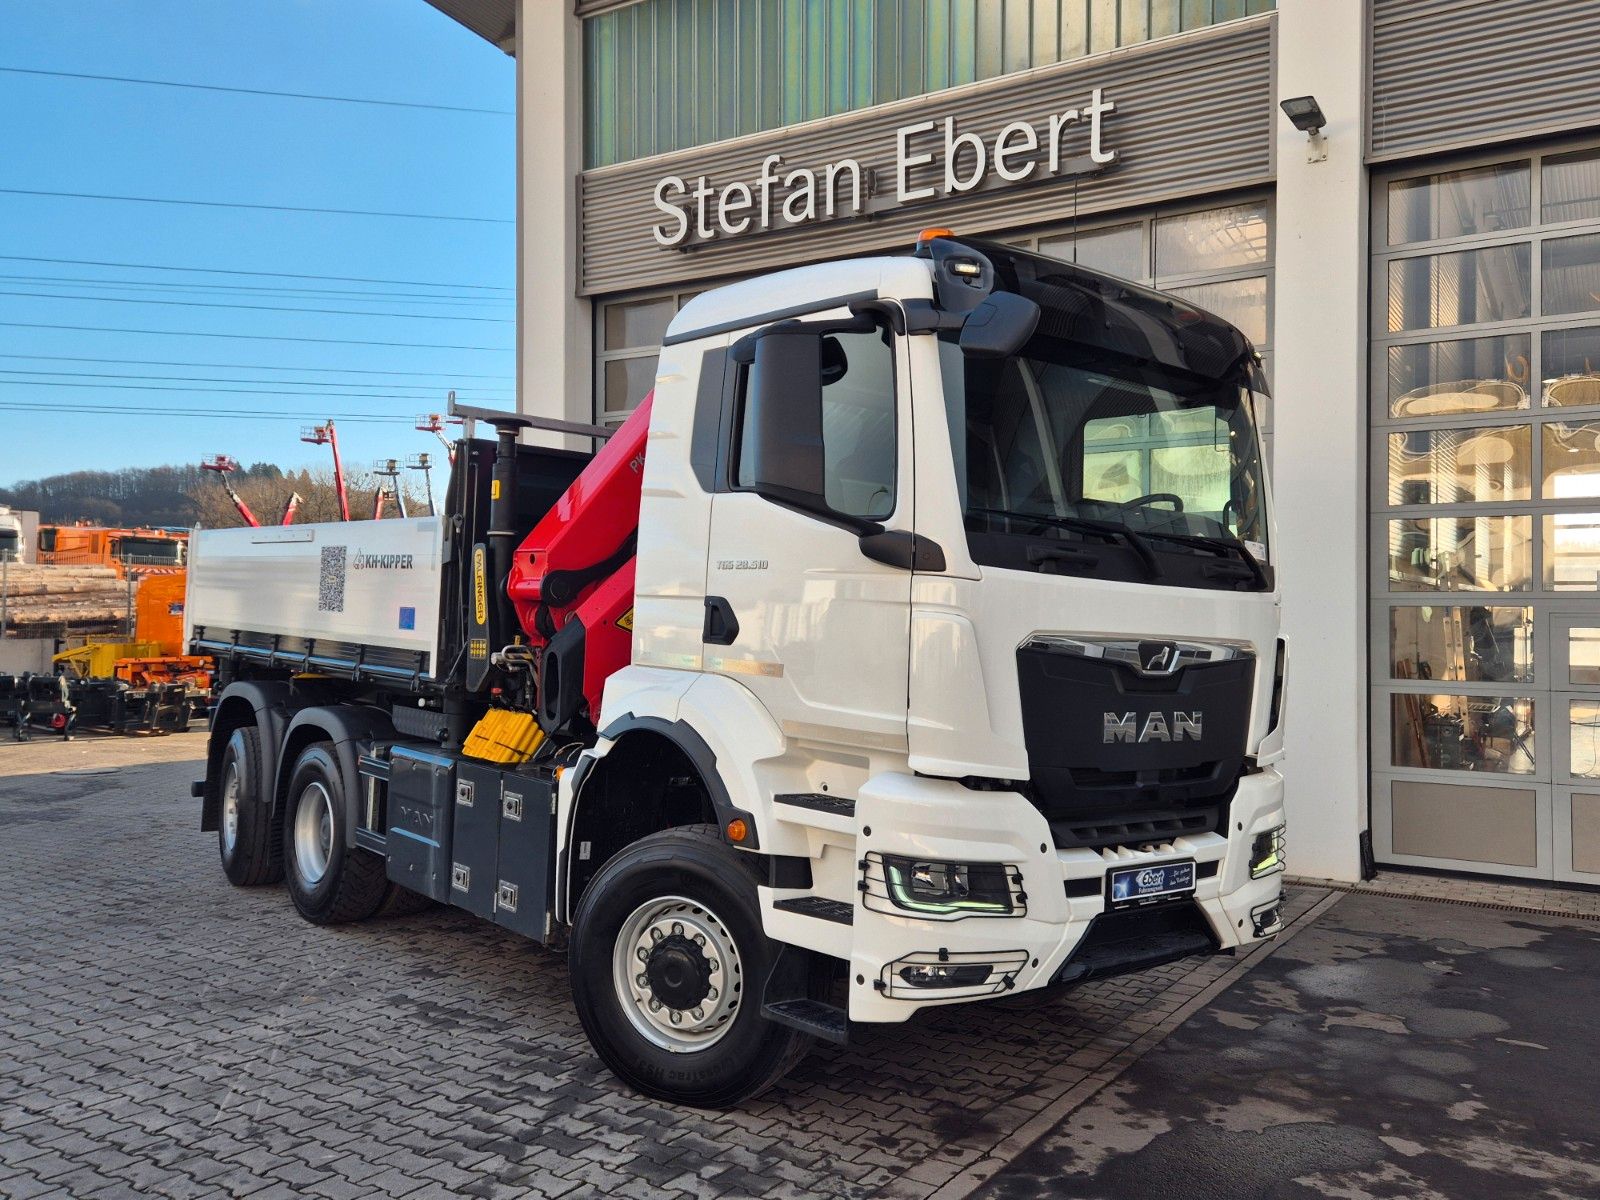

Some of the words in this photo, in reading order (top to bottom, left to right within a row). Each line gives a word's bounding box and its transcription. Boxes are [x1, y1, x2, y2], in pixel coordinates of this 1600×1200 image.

[653, 154, 863, 246] Stefan
[896, 88, 1118, 204] Ebert
[365, 554, 414, 570] KH-KIPPER
[475, 553, 484, 621] PALFINGER
[1102, 711, 1203, 744] MAN
